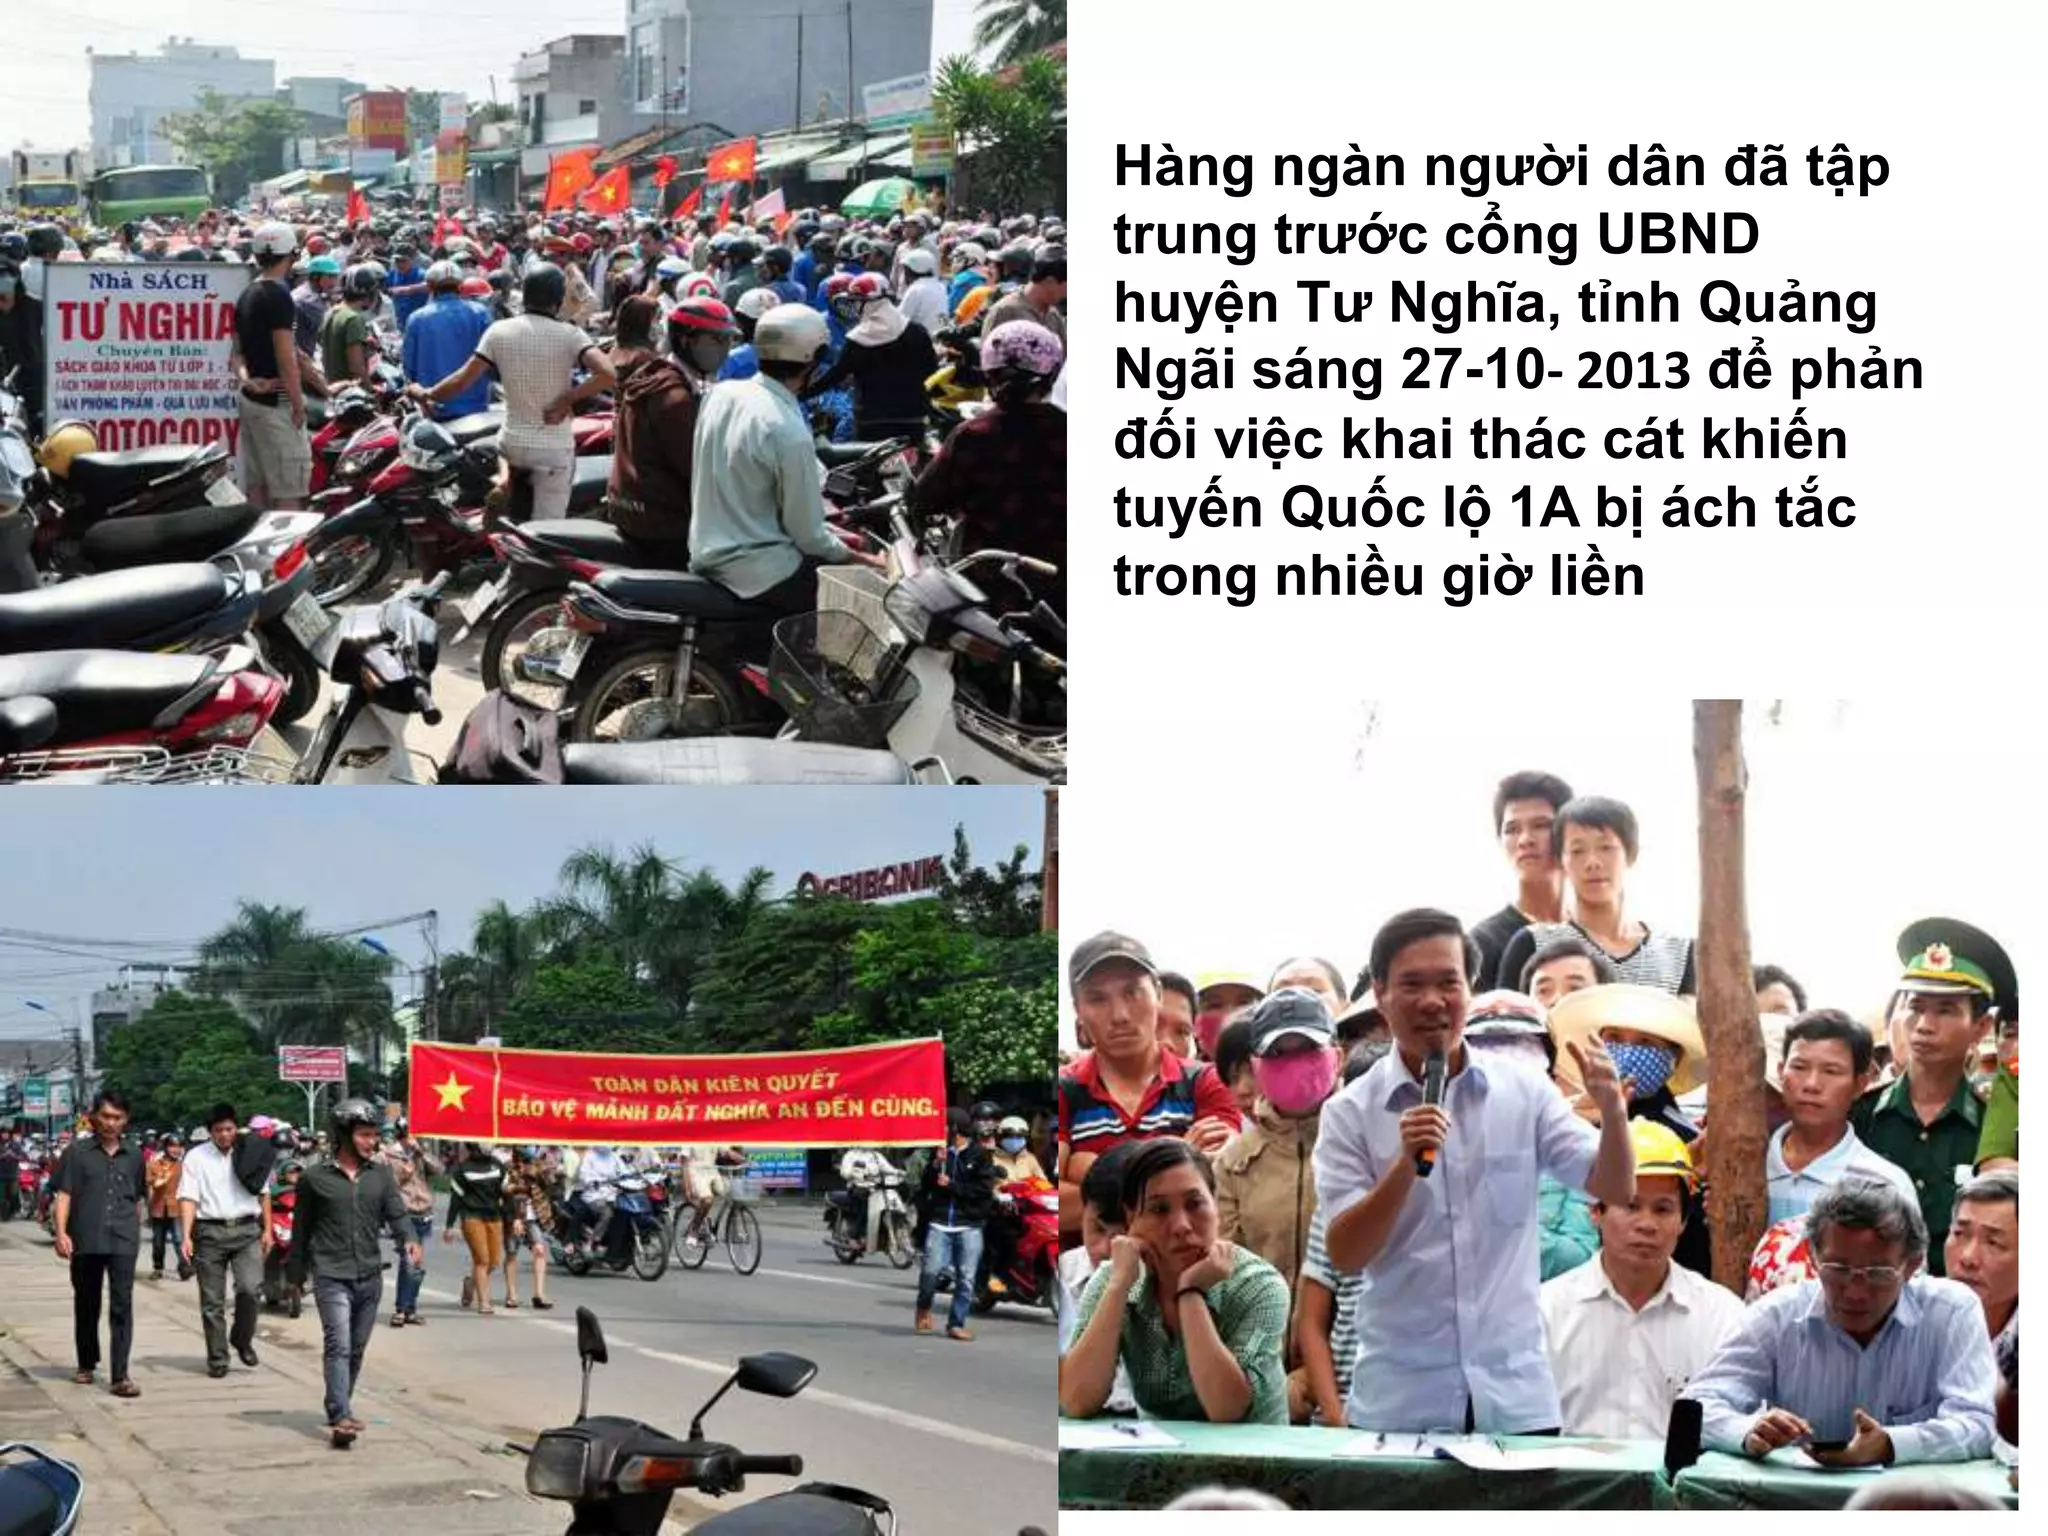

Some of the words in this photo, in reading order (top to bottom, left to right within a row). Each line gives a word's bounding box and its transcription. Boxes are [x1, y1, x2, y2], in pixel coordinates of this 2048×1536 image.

[142, 269, 208, 289] SÁCH
[56, 296, 111, 342] TƯ
[119, 293, 237, 341] NGHĨA
[123, 359, 156, 373] KHOA
[88, 418, 241, 455] OTOCOPY
[778, 1101, 809, 1119] AN
[871, 1094, 939, 1117] CÙNG.
